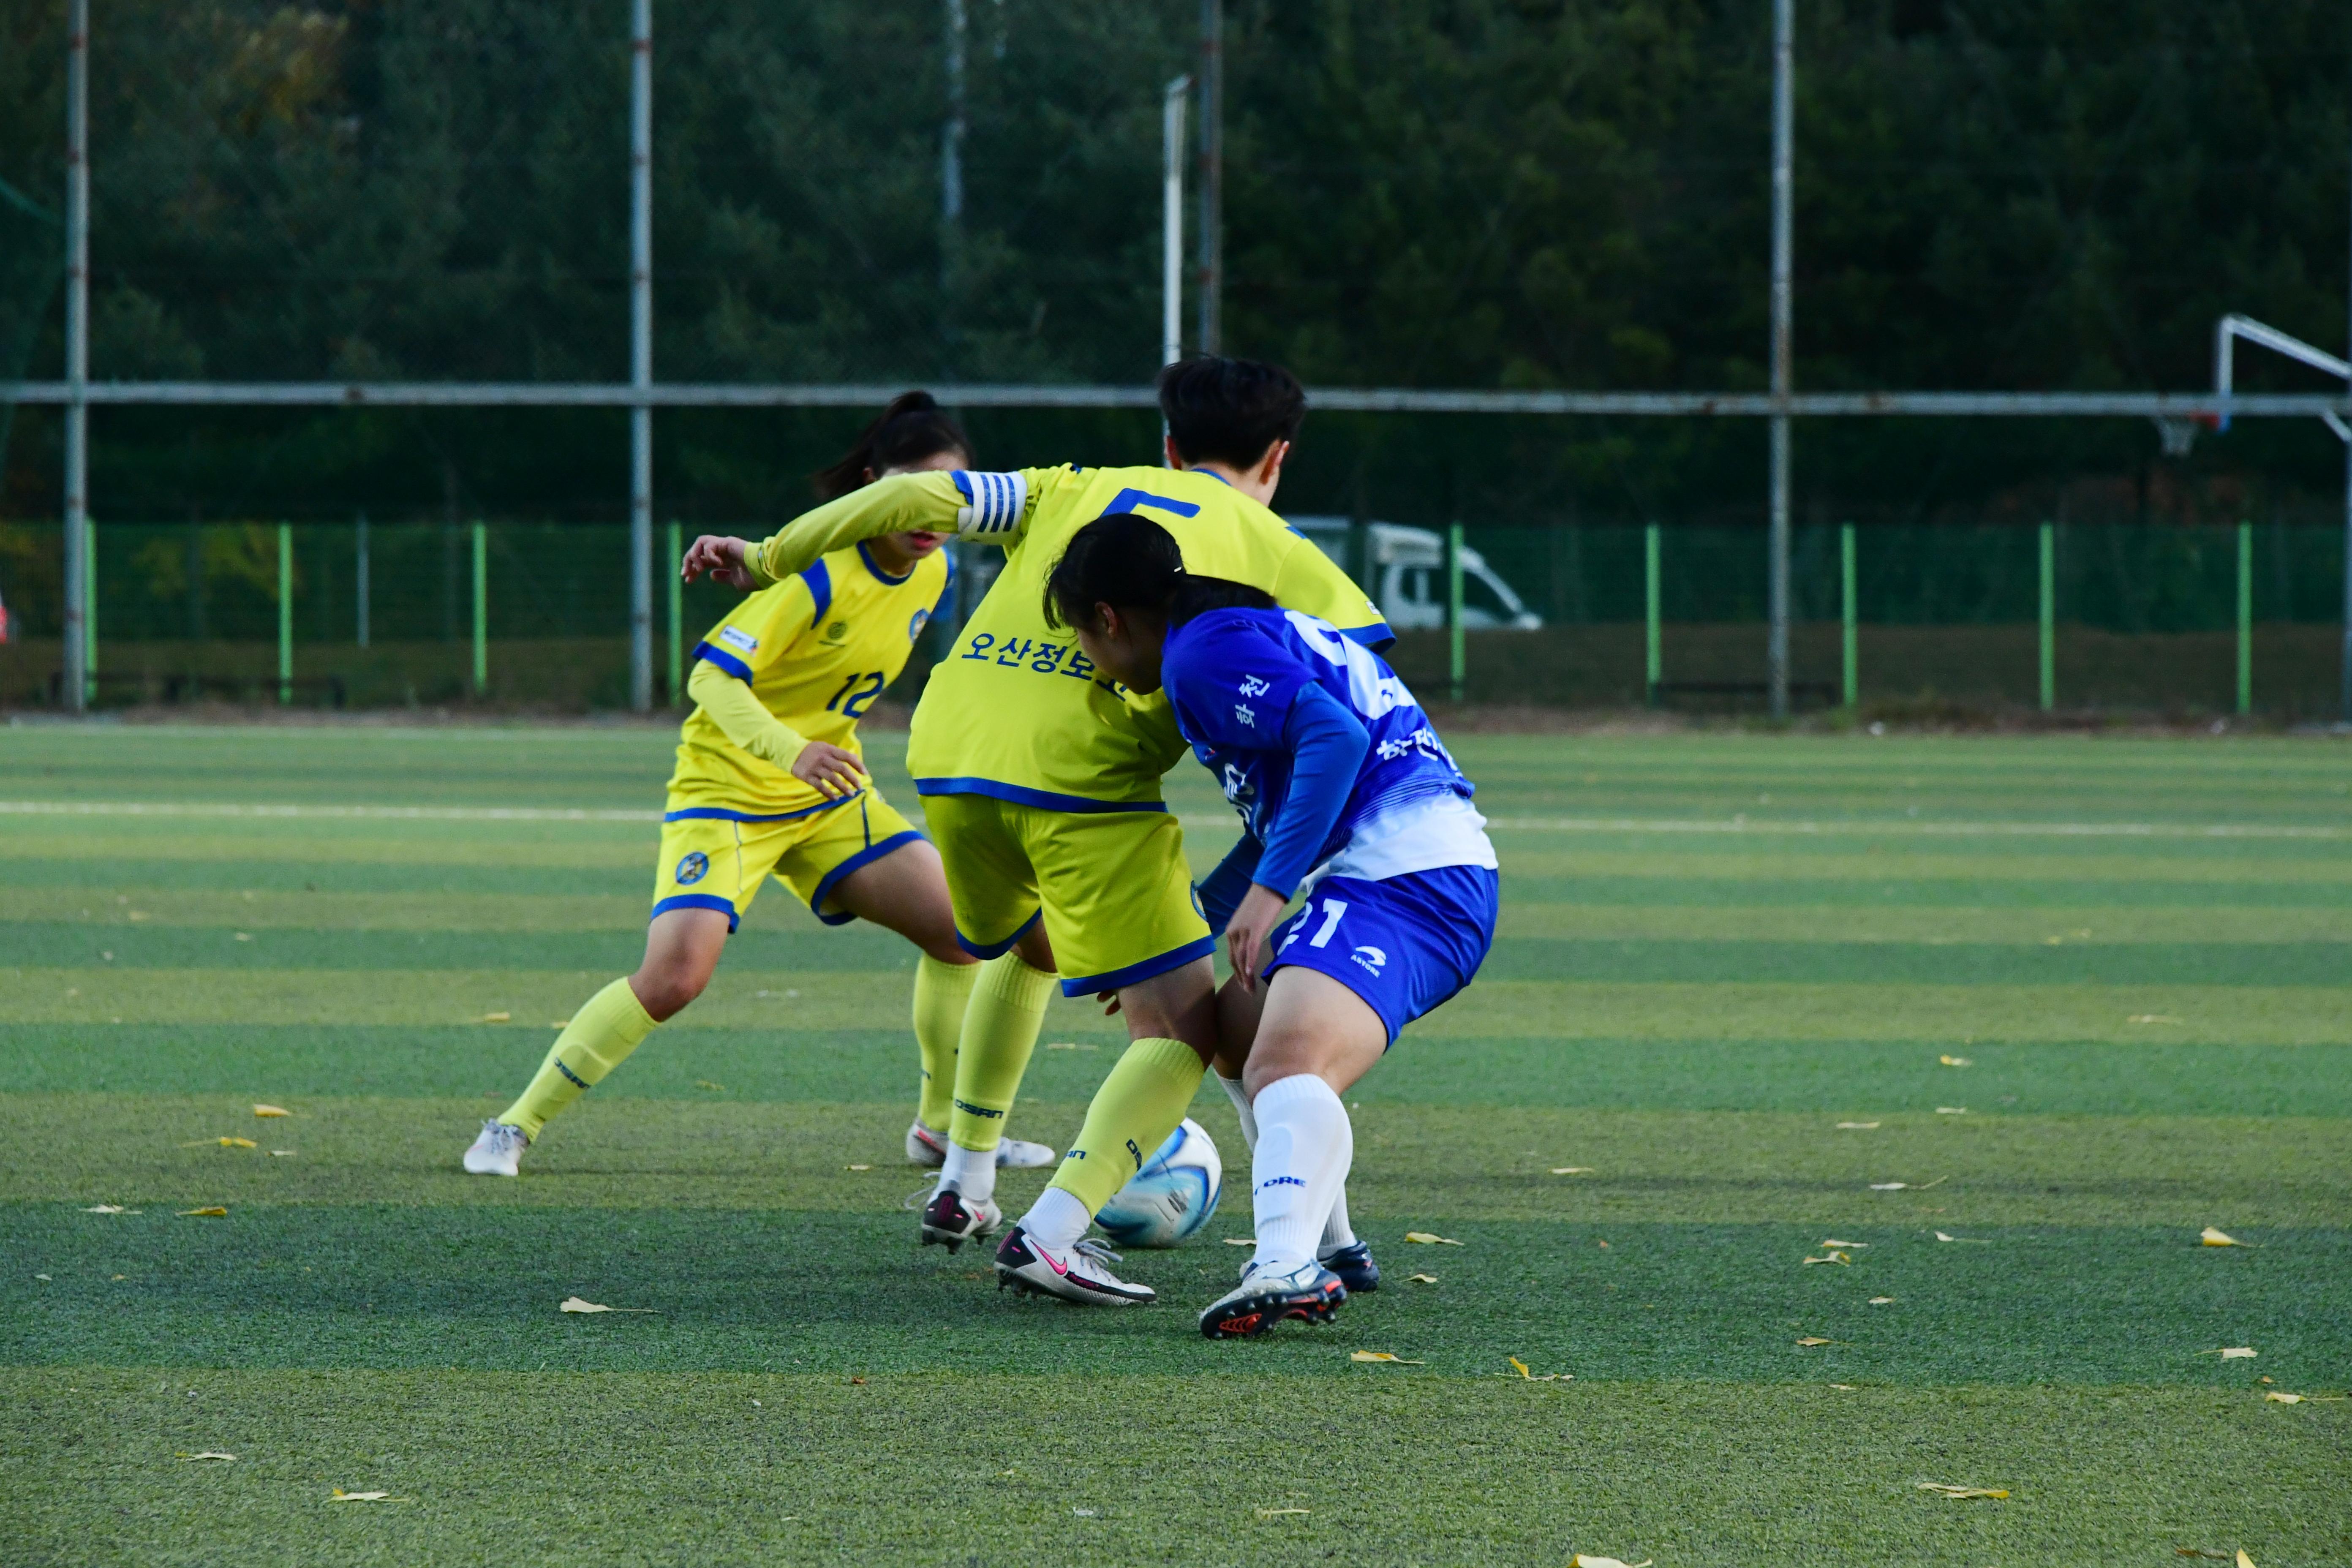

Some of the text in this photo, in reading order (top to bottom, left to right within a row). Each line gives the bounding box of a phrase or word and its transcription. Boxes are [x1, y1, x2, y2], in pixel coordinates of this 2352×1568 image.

[826, 671, 884, 719] 12
[1235, 674, 1270, 728] 화천
[1277, 898, 1348, 956] 21
[1350, 954, 1380, 978] ASTORE
